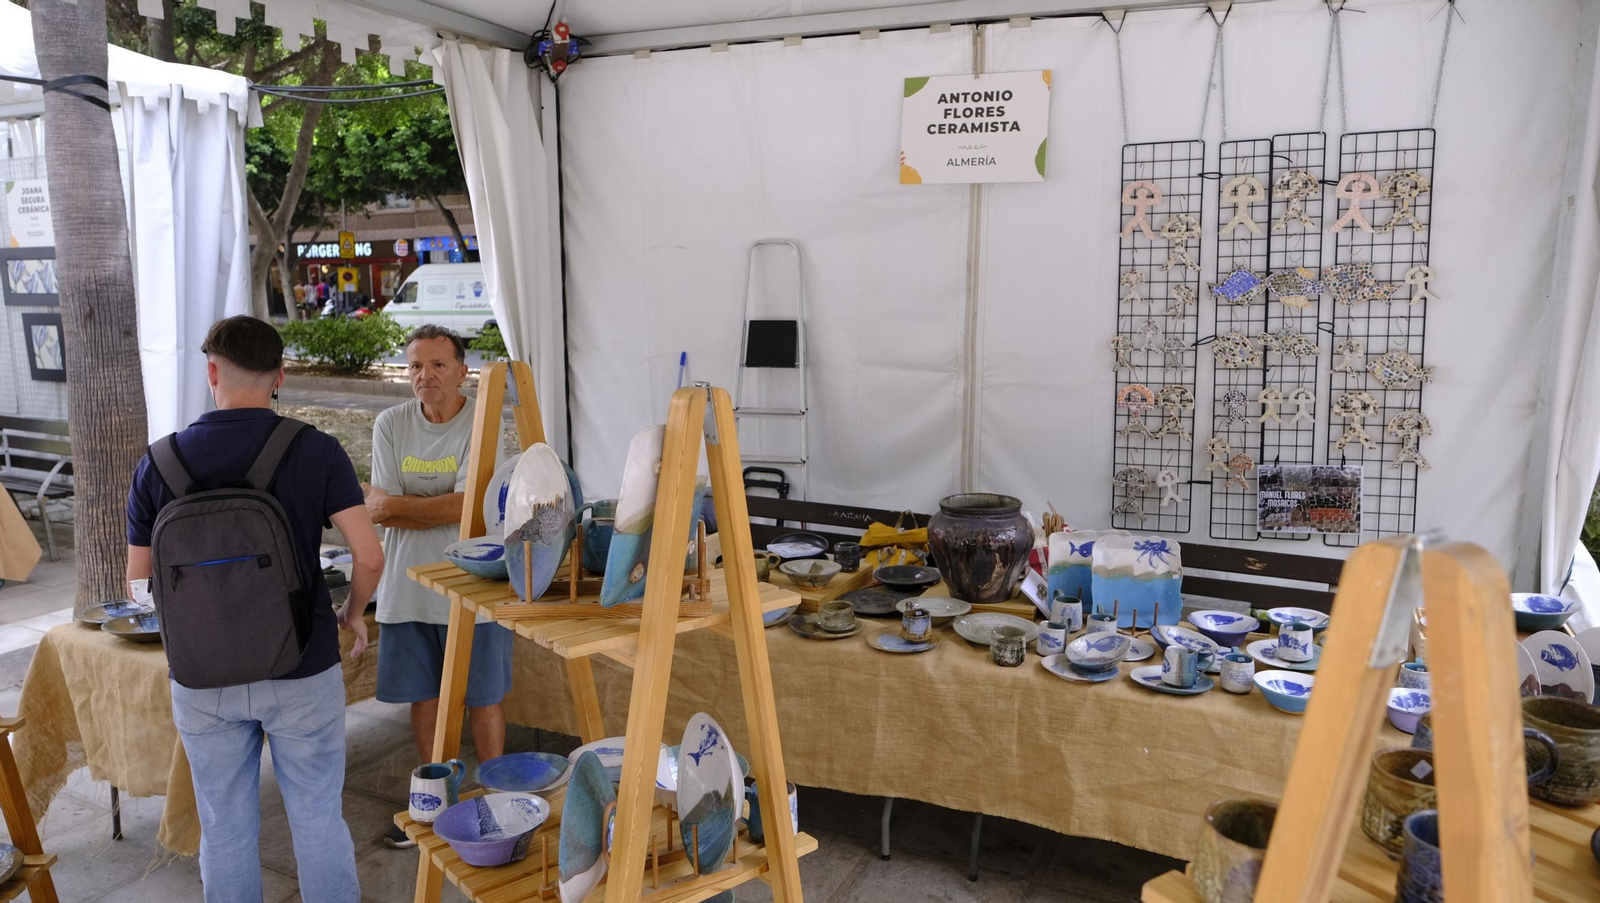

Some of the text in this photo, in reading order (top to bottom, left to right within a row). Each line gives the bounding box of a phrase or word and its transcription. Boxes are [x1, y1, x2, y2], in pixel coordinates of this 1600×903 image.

[937, 90, 1013, 105] ANTONIO
[943, 106, 1006, 119] FLORES
[927, 121, 1021, 135] CERAMISTA
[946, 155, 997, 167] ALMERÍA
[21, 187, 43, 195] JOANA
[401, 454, 458, 473] CHAMPION
[1260, 490, 1306, 500] MANUEL FLORES
